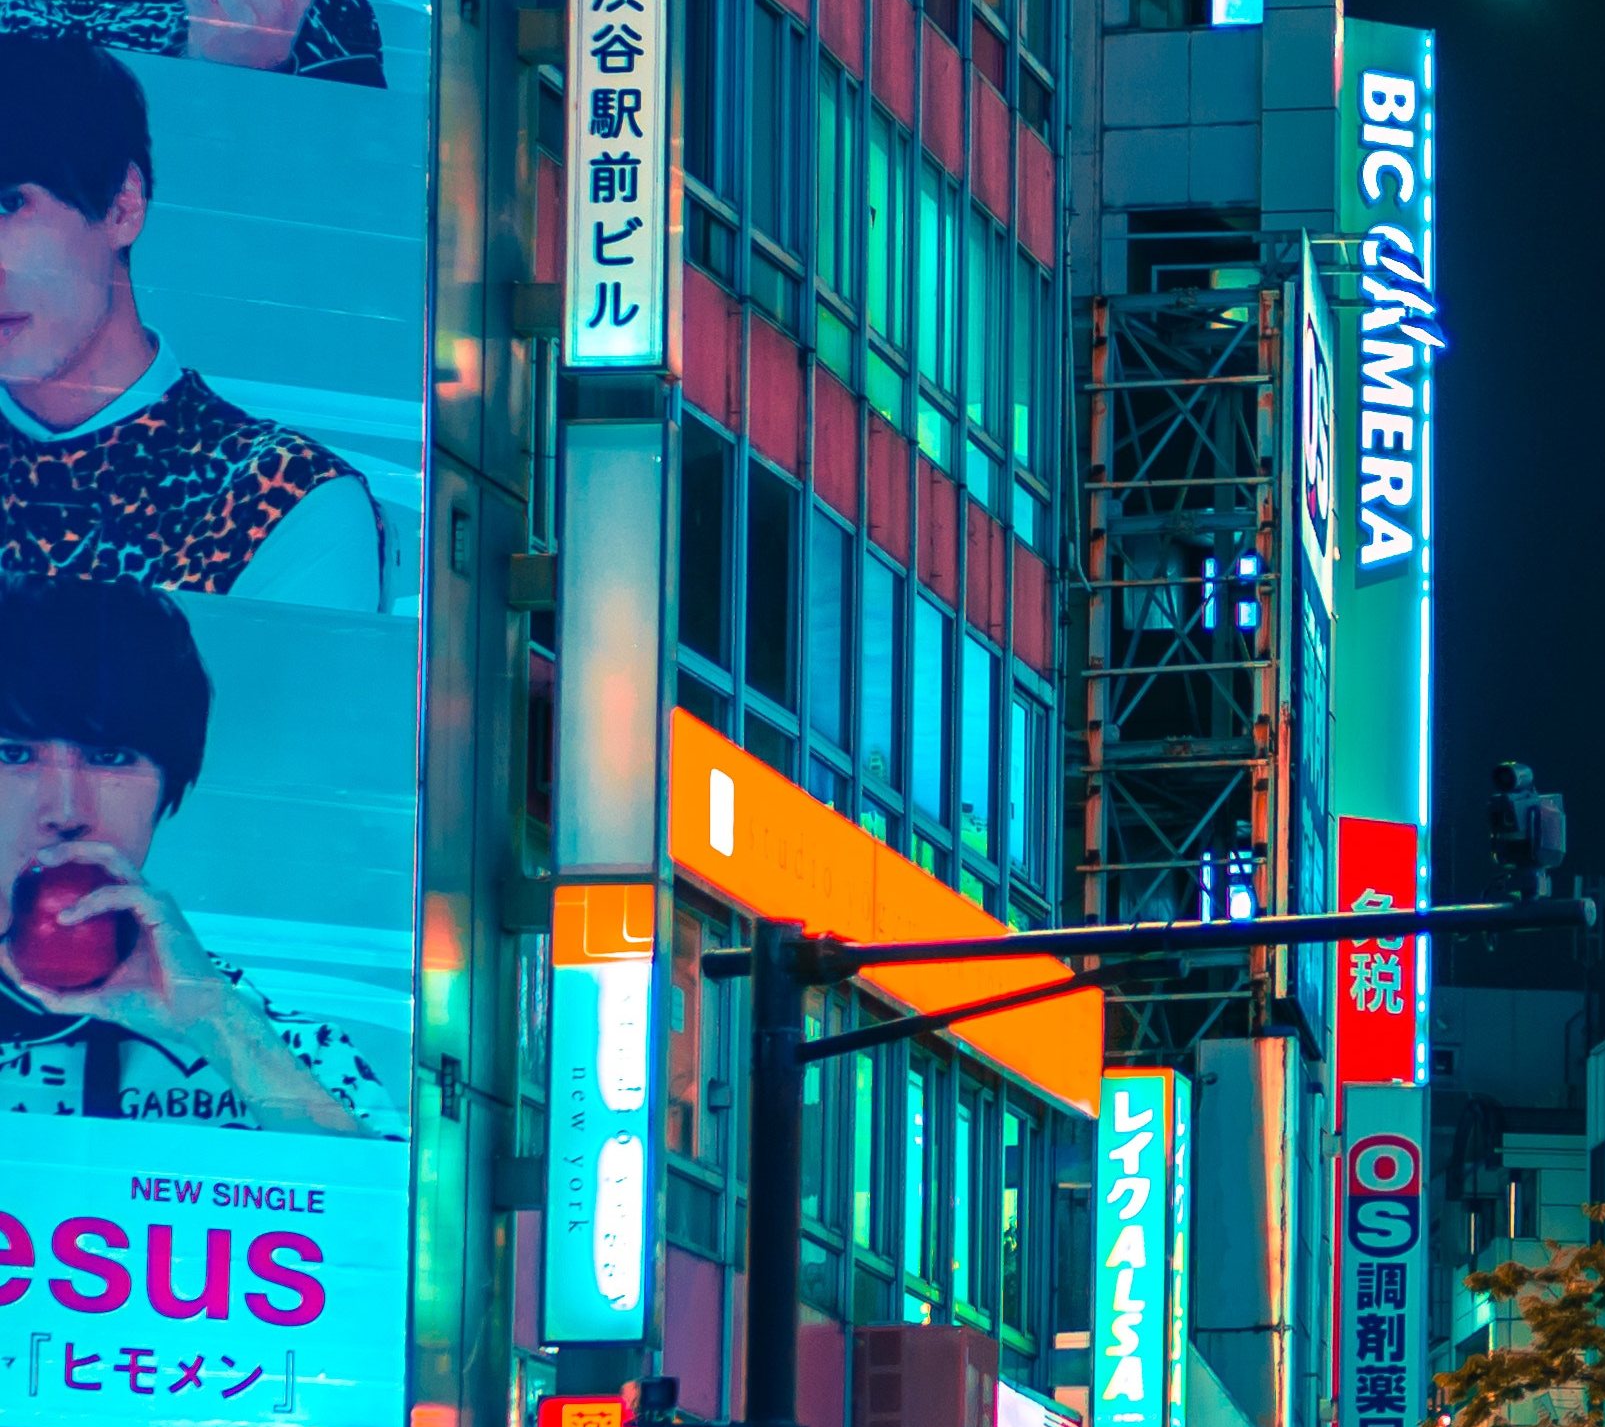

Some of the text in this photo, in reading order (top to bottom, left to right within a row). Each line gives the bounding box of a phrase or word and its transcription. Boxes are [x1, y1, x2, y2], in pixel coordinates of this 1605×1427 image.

[1359, 69, 1416, 209] BIC
[1359, 224, 1417, 570] CAMERA
[1349, 887, 1405, 1015] 免税
[130, 1176, 327, 1215] NEW SINGLE
[563, 1066, 590, 1234] new york
[1354, 1144, 1416, 1252] OS
